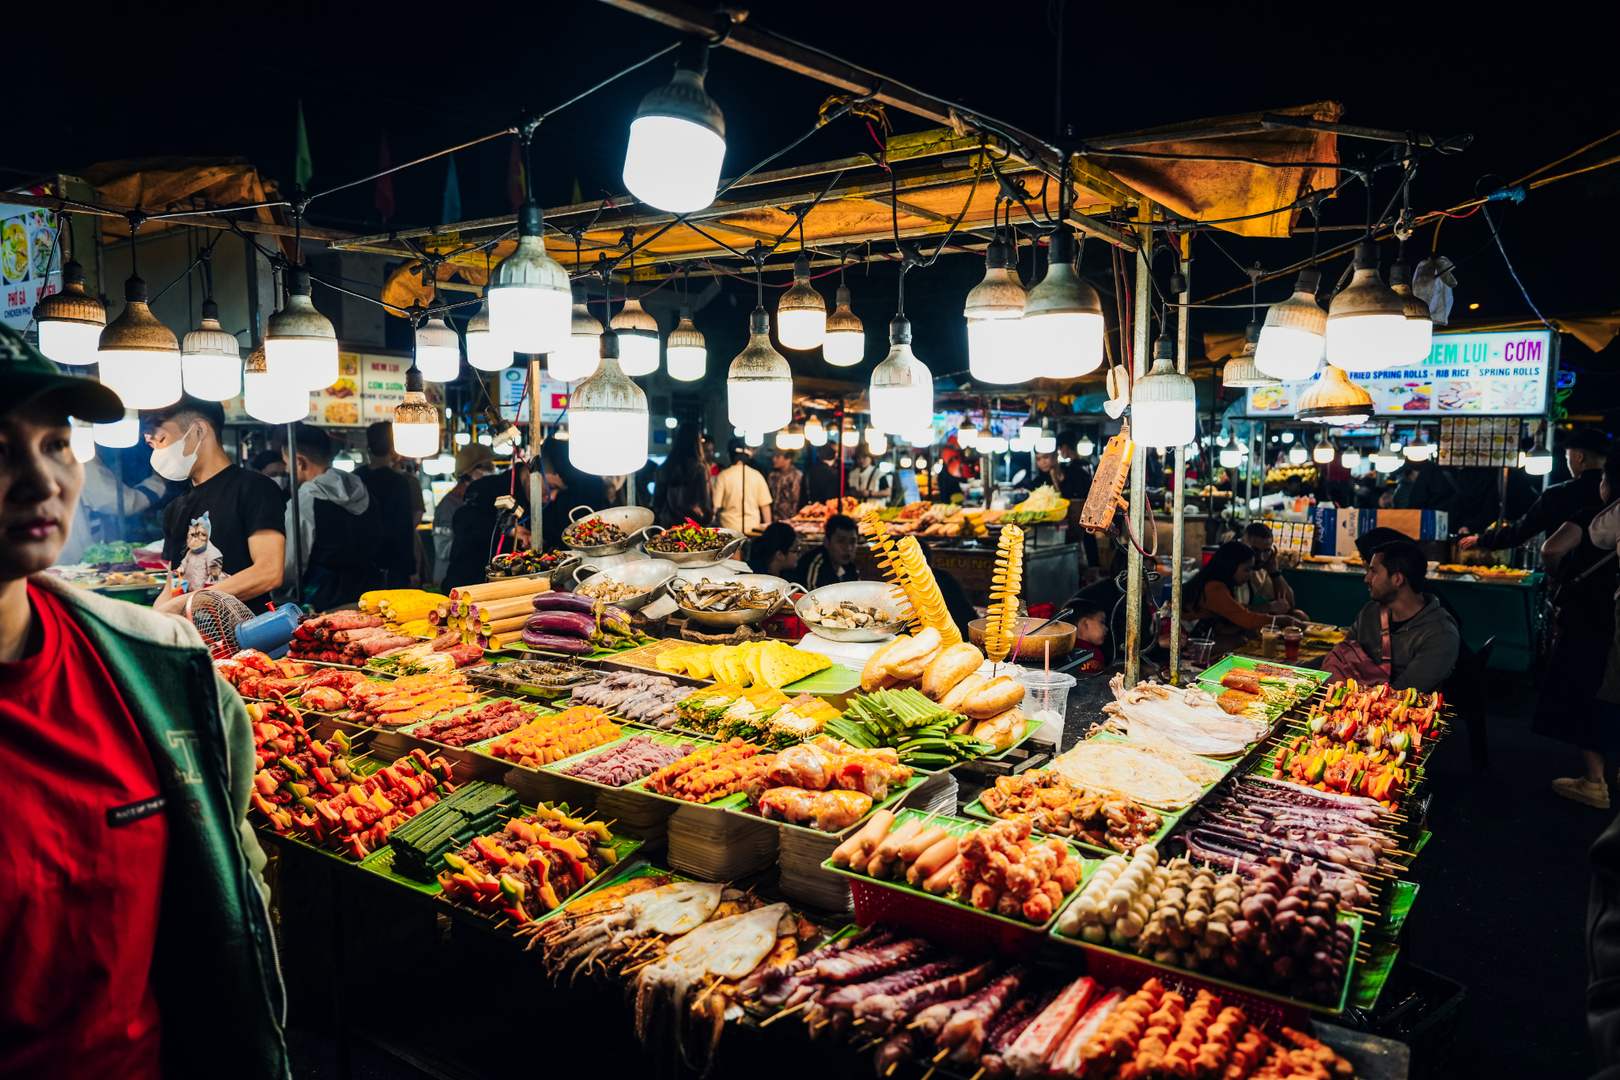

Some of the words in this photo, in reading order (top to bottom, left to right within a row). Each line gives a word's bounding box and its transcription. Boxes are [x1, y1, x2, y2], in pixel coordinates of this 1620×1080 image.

[1504, 338, 1542, 362] CƠM
[1349, 371, 1371, 380] FRIED
[1373, 370, 1402, 379] SPRING
[1403, 369, 1428, 379] ROLLS
[1435, 369, 1450, 378] RIB
[1451, 368, 1470, 377] RICE
[1479, 367, 1511, 377] SPRING
[1513, 367, 1540, 376] ROLLS
